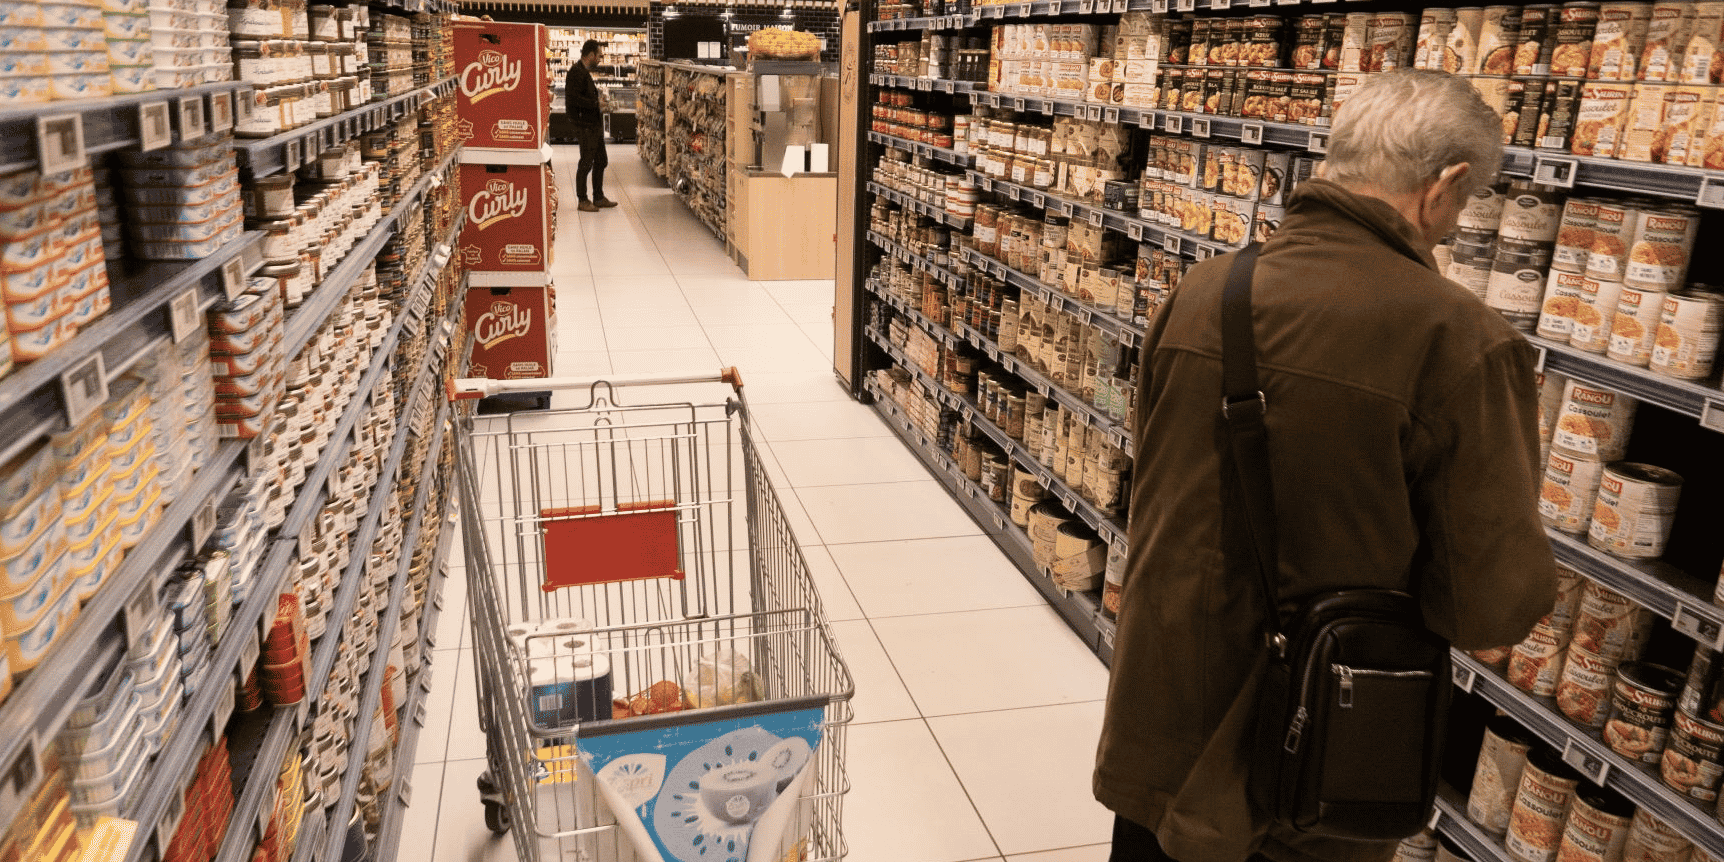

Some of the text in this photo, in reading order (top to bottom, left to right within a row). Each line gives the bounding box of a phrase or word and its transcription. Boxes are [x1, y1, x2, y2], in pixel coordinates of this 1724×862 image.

[730, 23, 761, 31] FUMOIR
[482, 53, 500, 64] Vico
[460, 54, 521, 97] Curly
[489, 182, 507, 193] Vico
[468, 183, 528, 224] Curly
[1648, 217, 1686, 230] RANOU
[1643, 233, 1683, 244] Cassoulet
[493, 303, 511, 314] Vico
[475, 304, 531, 345] Curly
[1574, 387, 1611, 404] RANOU
[1568, 403, 1612, 418] Cassoulet
[1633, 690, 1673, 708] SAURIN
[1683, 718, 1723, 742] SAURIN
[1523, 776, 1564, 804] RANOU
[1519, 790, 1563, 819] Cassoulet
[1570, 809, 1609, 839] RANOU
